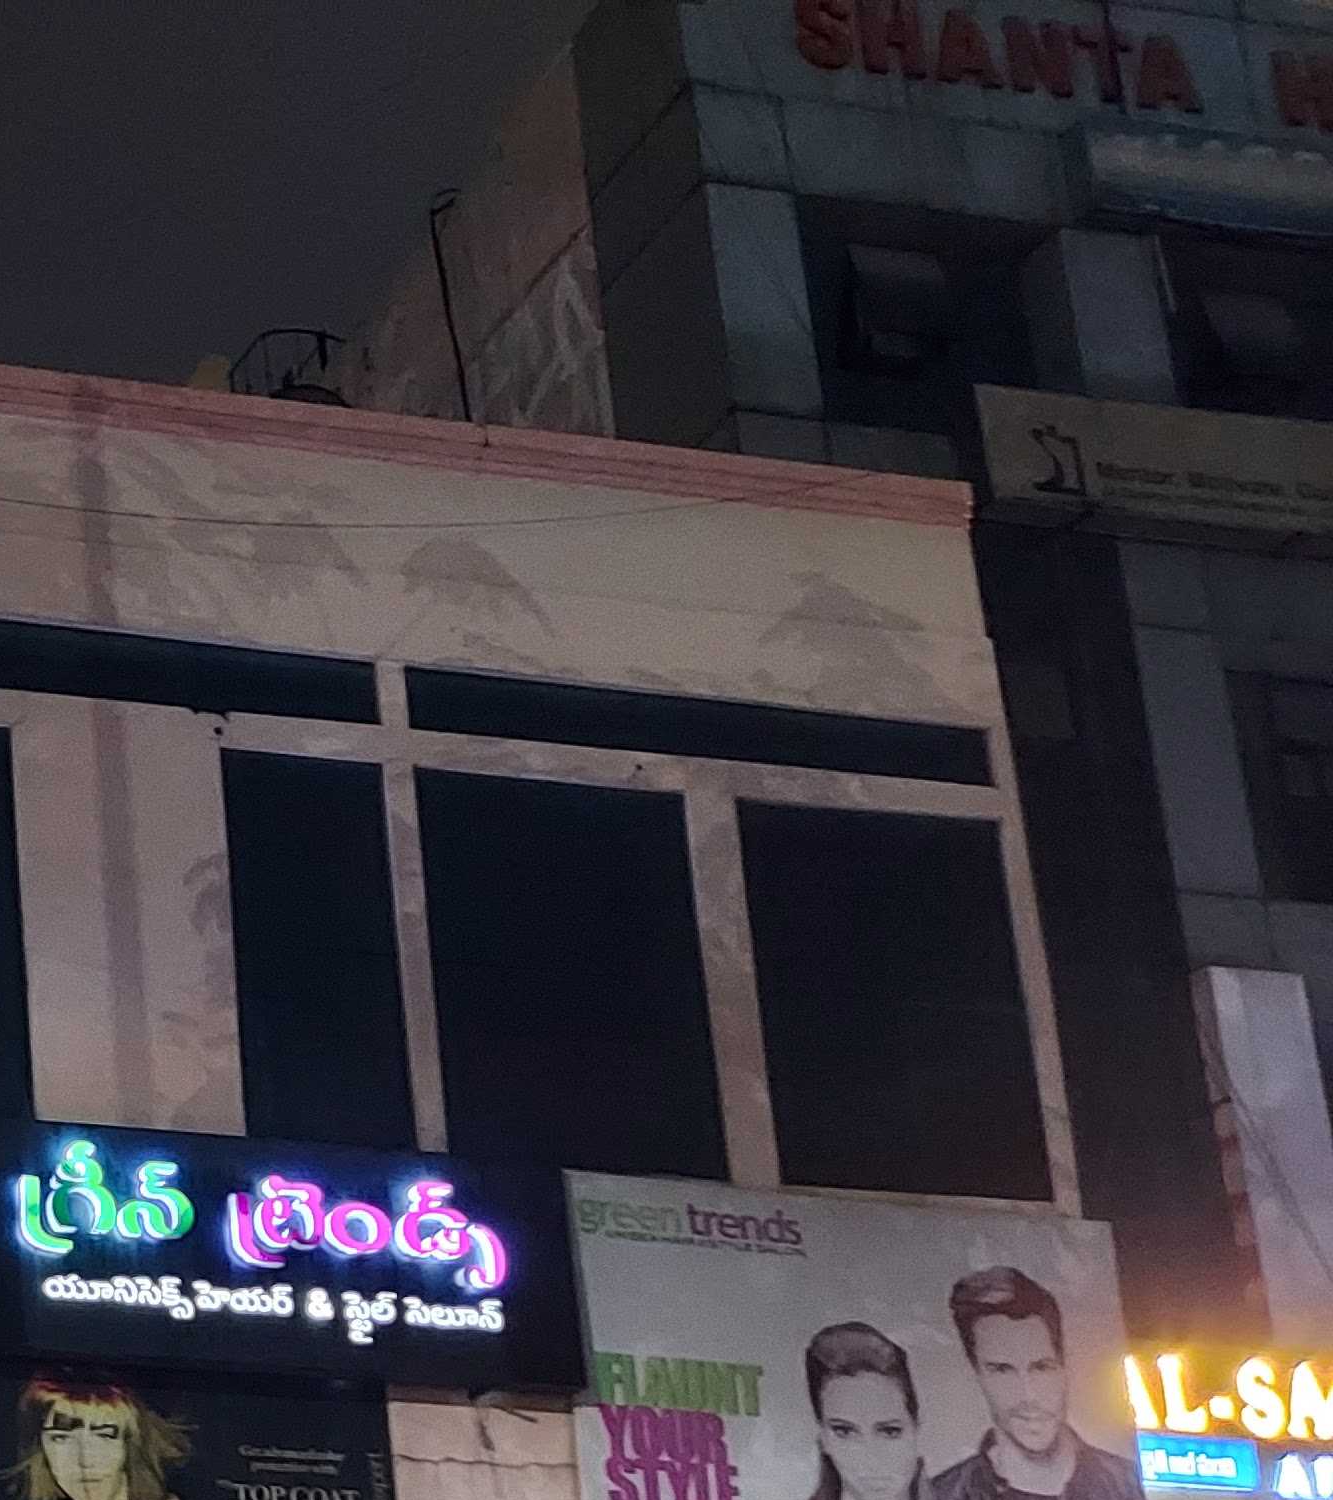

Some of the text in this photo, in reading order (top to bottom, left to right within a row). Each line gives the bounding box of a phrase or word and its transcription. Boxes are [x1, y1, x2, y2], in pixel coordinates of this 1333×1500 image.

[16, 1138, 197, 1255] గ్రీన్
[686, 1202, 803, 1246] trends
[596, 1402, 729, 1466] YOUR
